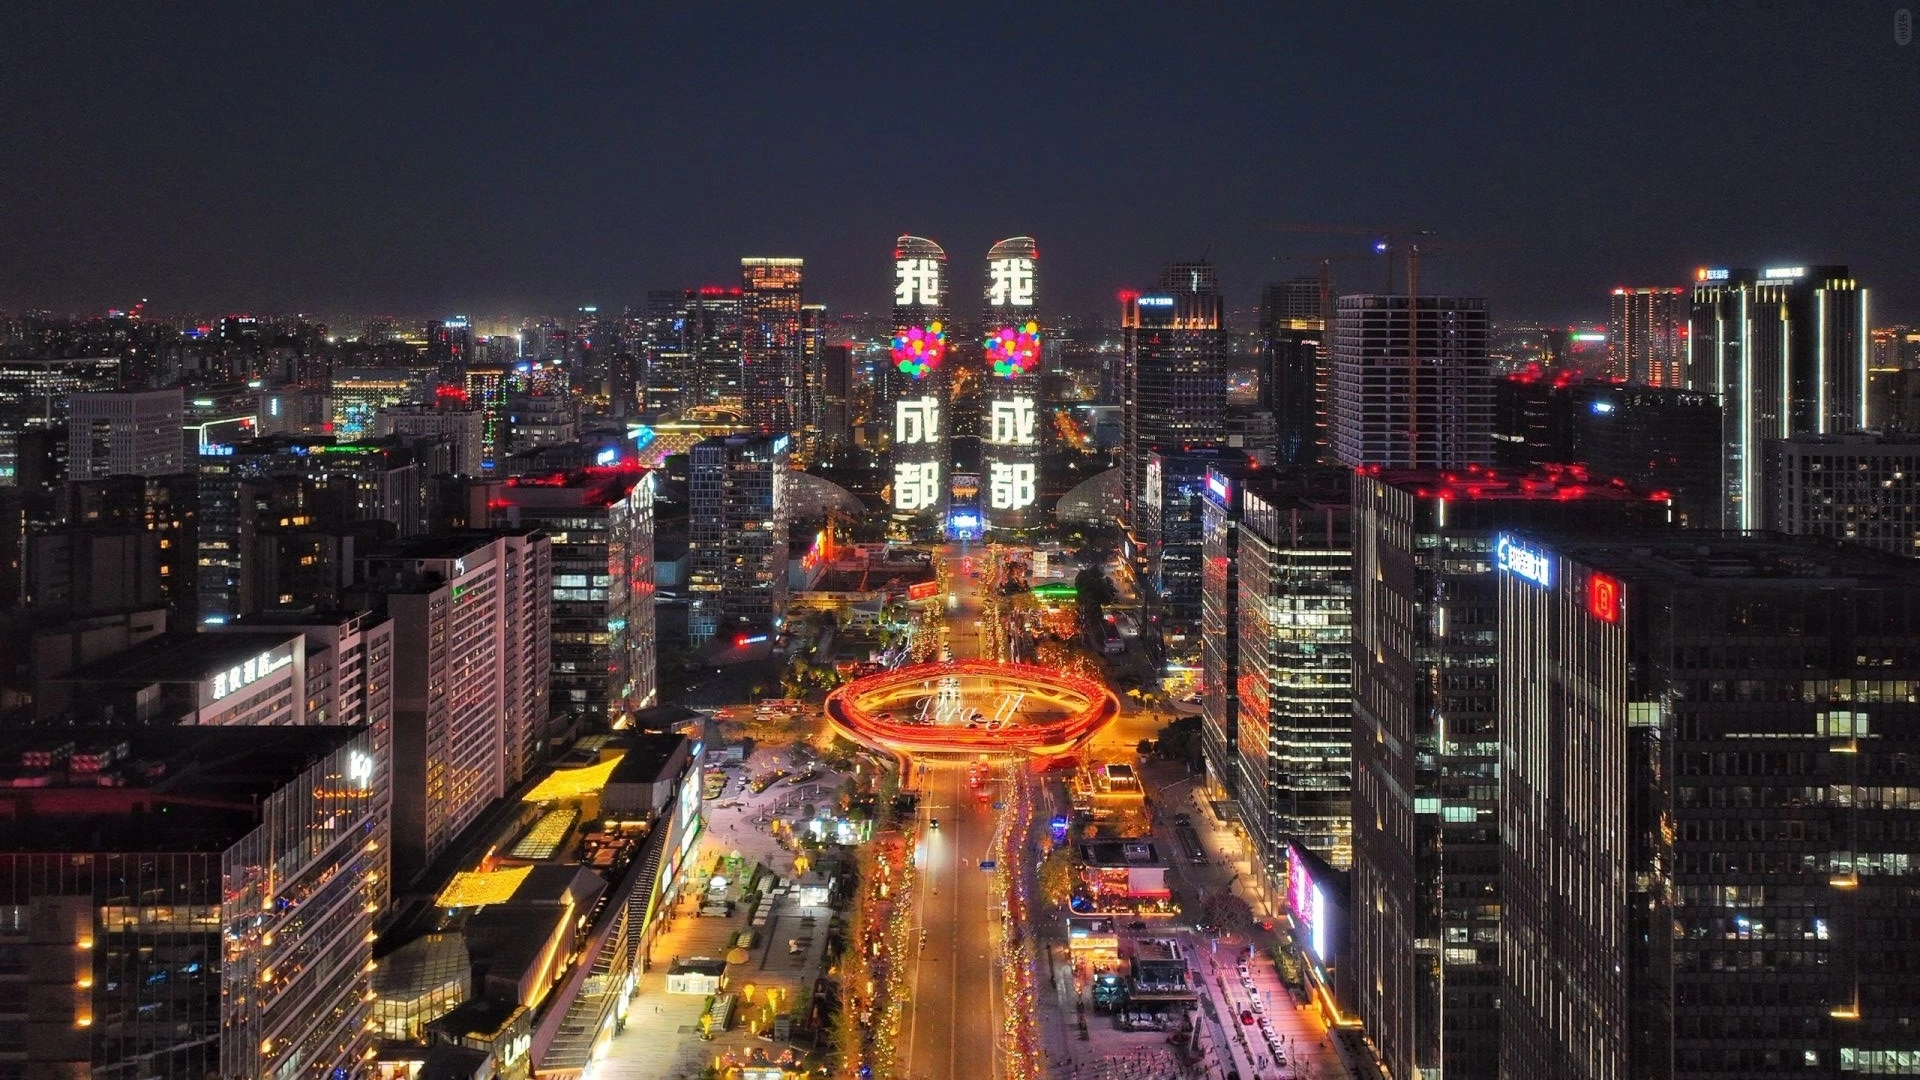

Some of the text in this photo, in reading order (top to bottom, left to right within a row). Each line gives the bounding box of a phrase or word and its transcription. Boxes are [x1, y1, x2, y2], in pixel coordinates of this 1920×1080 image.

[894, 258, 939, 510] 我 成都
[990, 258, 1035, 510] 我 成都
